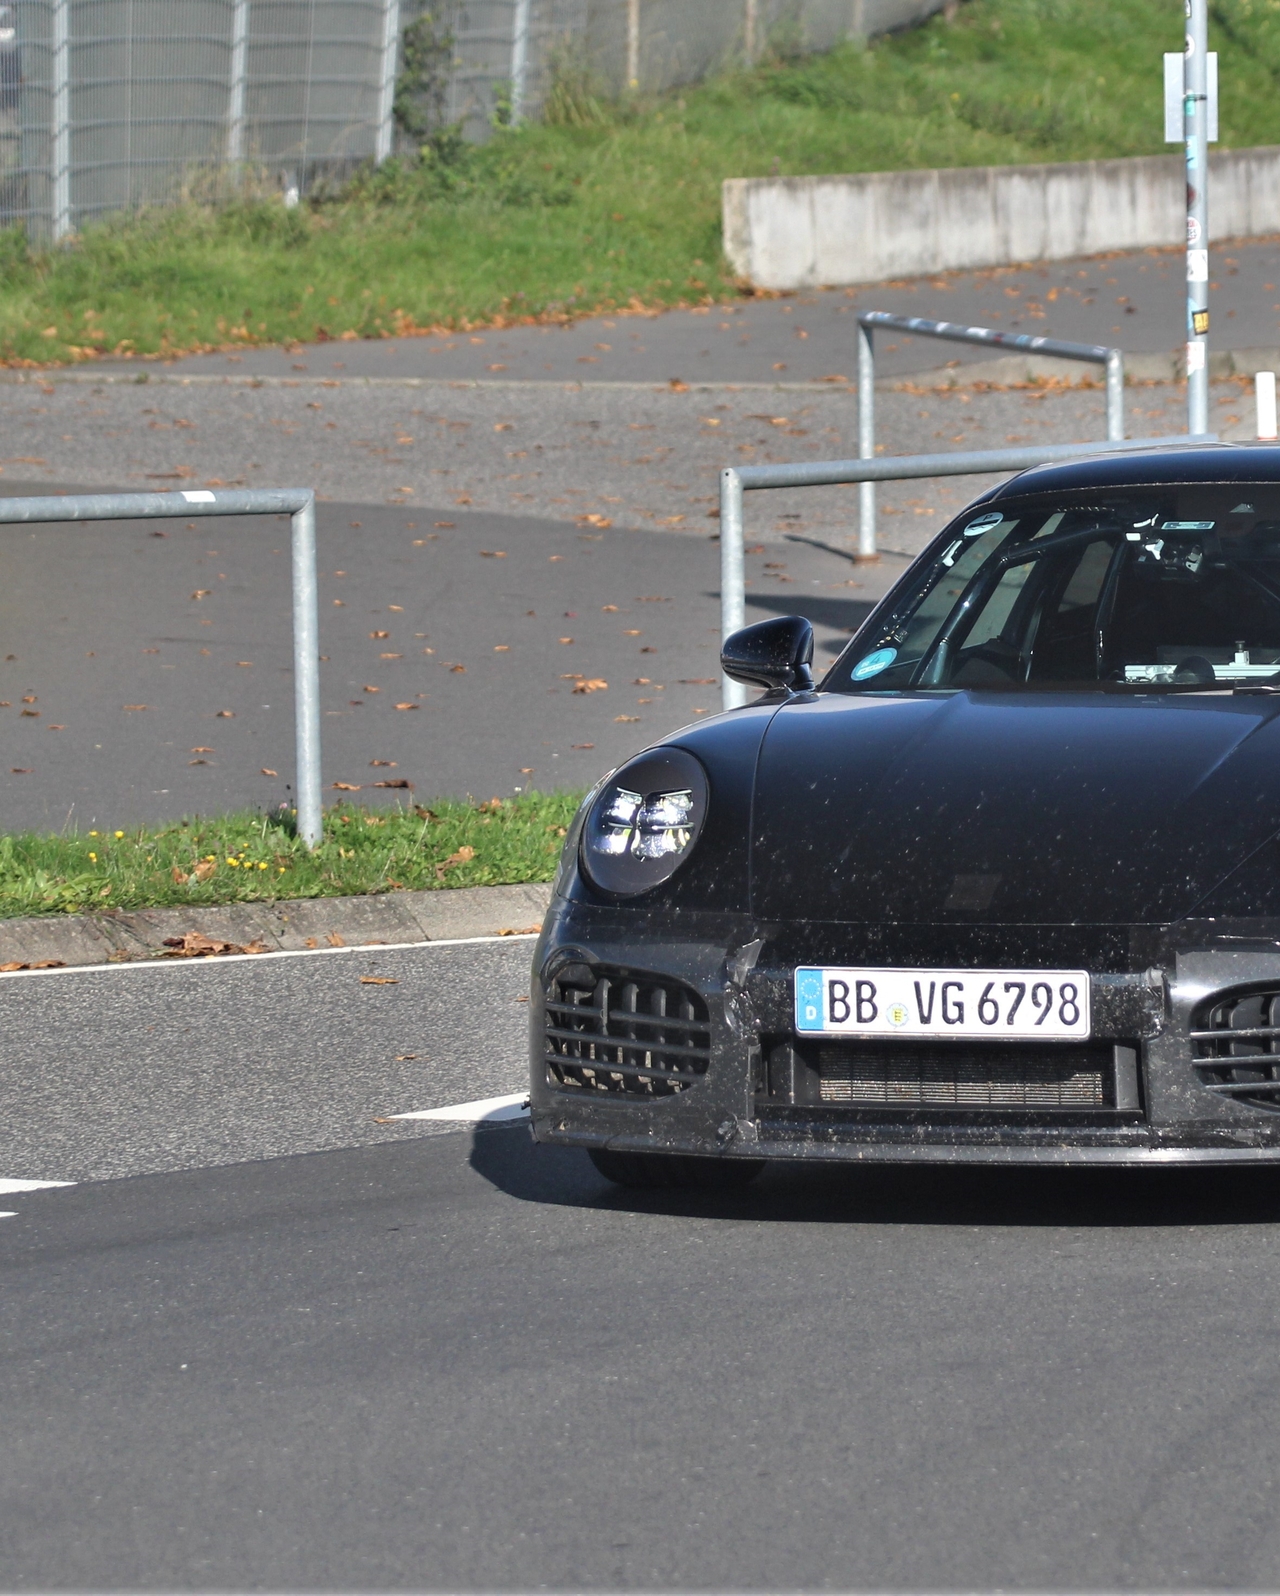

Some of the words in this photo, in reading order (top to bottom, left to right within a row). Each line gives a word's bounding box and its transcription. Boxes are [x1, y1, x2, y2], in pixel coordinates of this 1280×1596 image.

[806, 1005, 817, 1020] D
[828, 979, 879, 1024] BB
[913, 980, 965, 1026] VG
[977, 981, 1081, 1027] 6798
